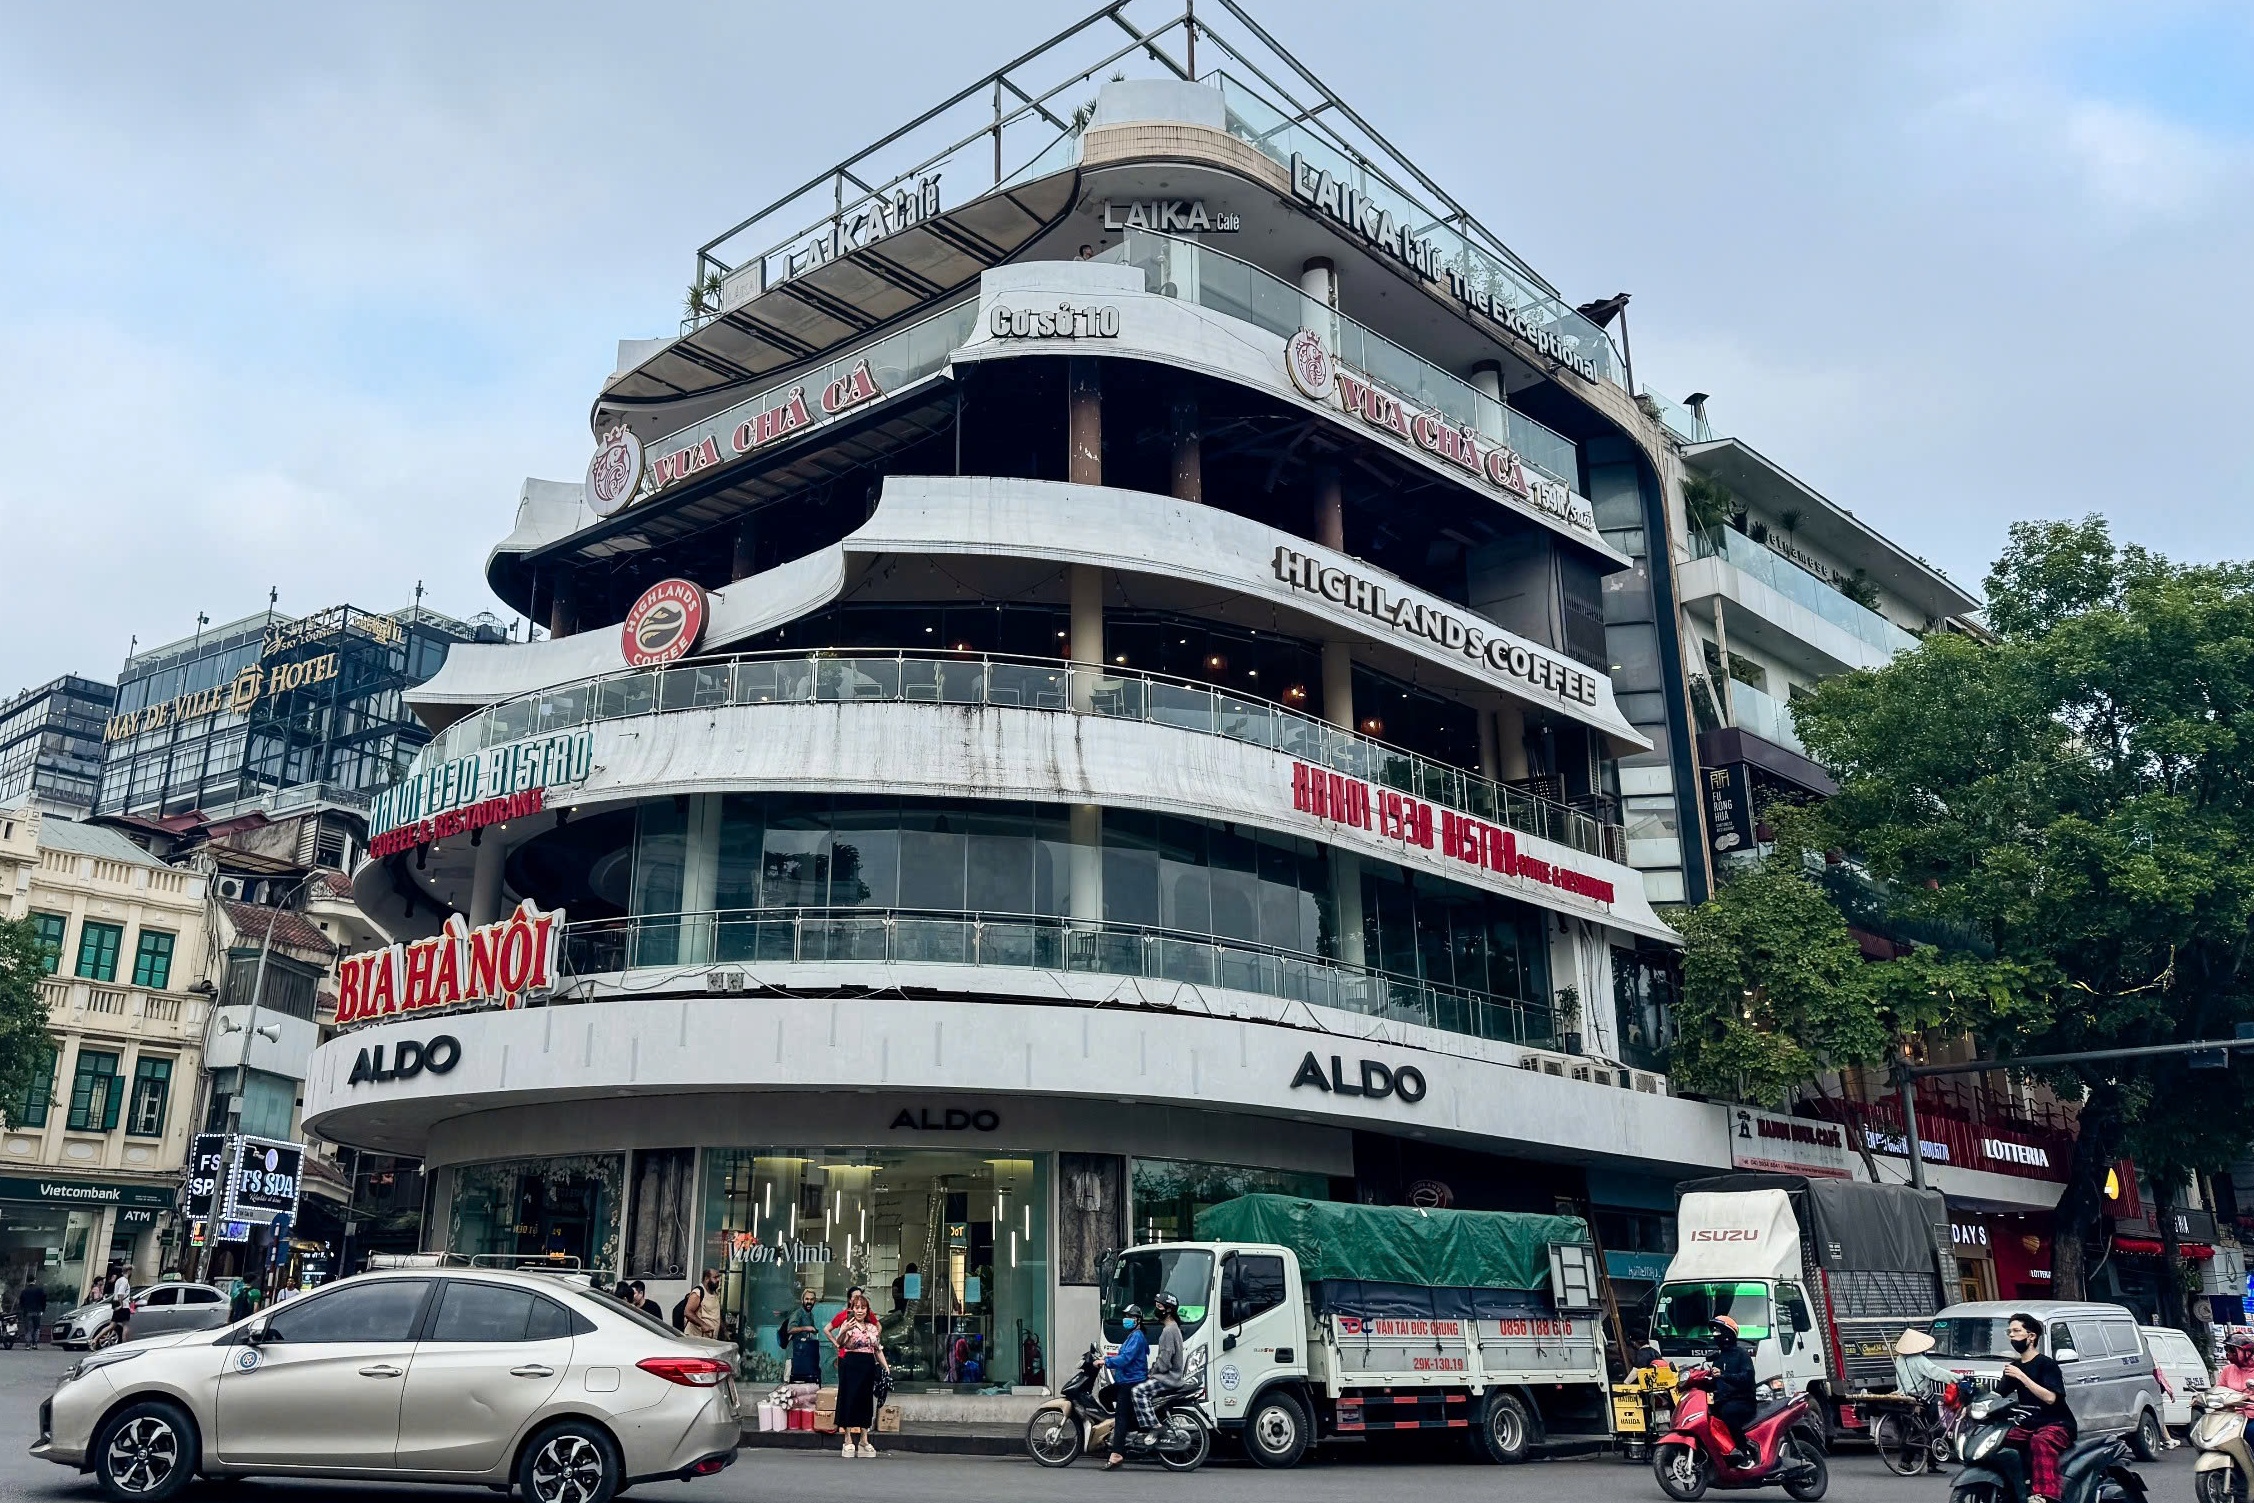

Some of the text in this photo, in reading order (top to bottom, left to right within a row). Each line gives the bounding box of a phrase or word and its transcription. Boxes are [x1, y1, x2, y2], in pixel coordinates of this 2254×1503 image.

[783, 174, 942, 281] LAIKA Café
[1104, 200, 1241, 232] LAIKA Café
[1291, 152, 1599, 385] LAIKA Café The Exceptional
[1081, 305, 1120, 338] 10
[652, 435, 724, 488] VUA
[732, 386, 815, 454] CHẢ
[1335, 373, 1411, 441] VUA
[1411, 412, 1484, 476] CHẢ
[627, 584, 697, 665] HIGHLANDS COFFEE
[1275, 546, 1597, 707] HIGHLANDS COFFEE
[281, 639, 298, 652] SKY
[102, 653, 339, 743] MAY DE VILLE HOTEL
[367, 731, 593, 840] HANOI 1930 BISTRO
[1712, 791, 1722, 802] FU
[1293, 762, 1372, 831] HANOI
[1377, 789, 1434, 850] 1930
[1441, 809, 1518, 877] BISTRO
[1713, 799, 1733, 812] RONG
[1714, 810, 1730, 822] HUA
[370, 787, 546, 859] COFFEE & RESTAURANT
[334, 898, 566, 1029] BIA HÀ NỘI
[347, 1034, 462, 1085] ALDO
[1290, 1050, 1427, 1104] ALDO
[889, 1108, 1000, 1132] ALDO
[200, 1154, 221, 1171] FS
[1982, 1138, 2050, 1168] LOTTERIA
[40, 1183, 121, 1202] Vietcombank
[240, 1169, 263, 1193] FS
[264, 1172, 294, 1199] SPA
[124, 1210, 151, 1223] ATM
[1691, 1230, 1758, 1242] ISUZU
[1951, 1223, 1987, 1246] DAYS
[1431, 1321, 1458, 1336] CHUNG
[1500, 1319, 1527, 1336] 0856
[1413, 1357, 1463, 1371] 29K-130.19
